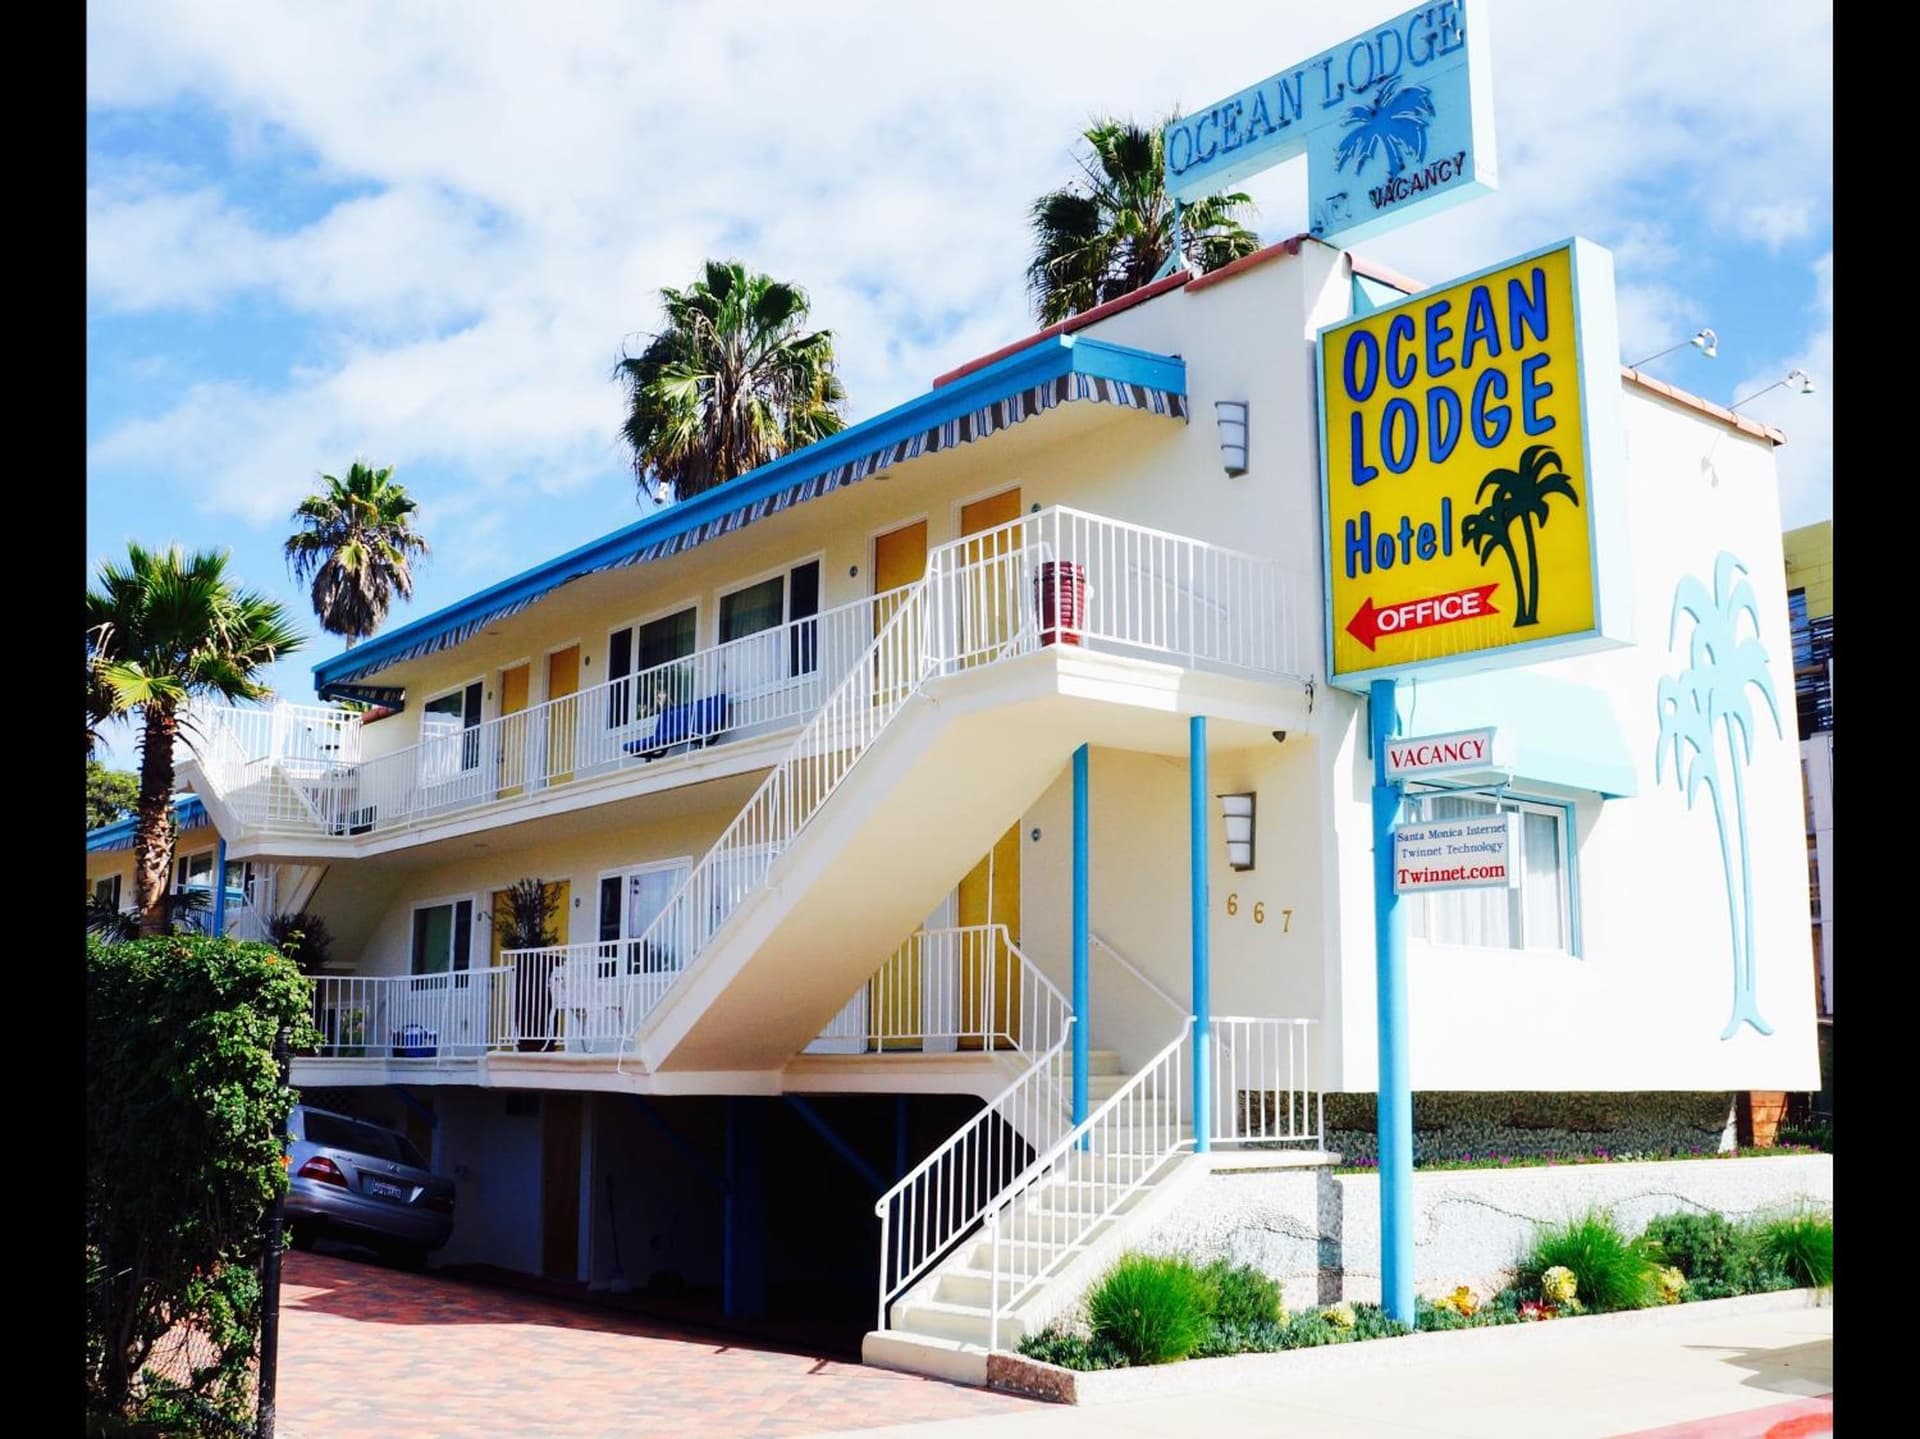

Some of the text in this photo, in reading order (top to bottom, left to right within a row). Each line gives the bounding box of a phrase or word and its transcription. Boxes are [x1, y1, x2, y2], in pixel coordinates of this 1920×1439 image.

[1169, 1, 1465, 176] OCEAN LODGE
[1368, 151, 1466, 209] VACANCY
[1343, 267, 1549, 403] OCEAN
[1351, 352, 1556, 487] LODGE
[1345, 496, 1453, 579] Hotel
[1376, 593, 1480, 632] OFFICE
[1391, 739, 1485, 768] VACANCY
[1397, 823, 1506, 842] Santa Monica Internet
[1402, 842, 1504, 859] Twinnet Technology
[1398, 865, 1505, 884] Twinnet.com
